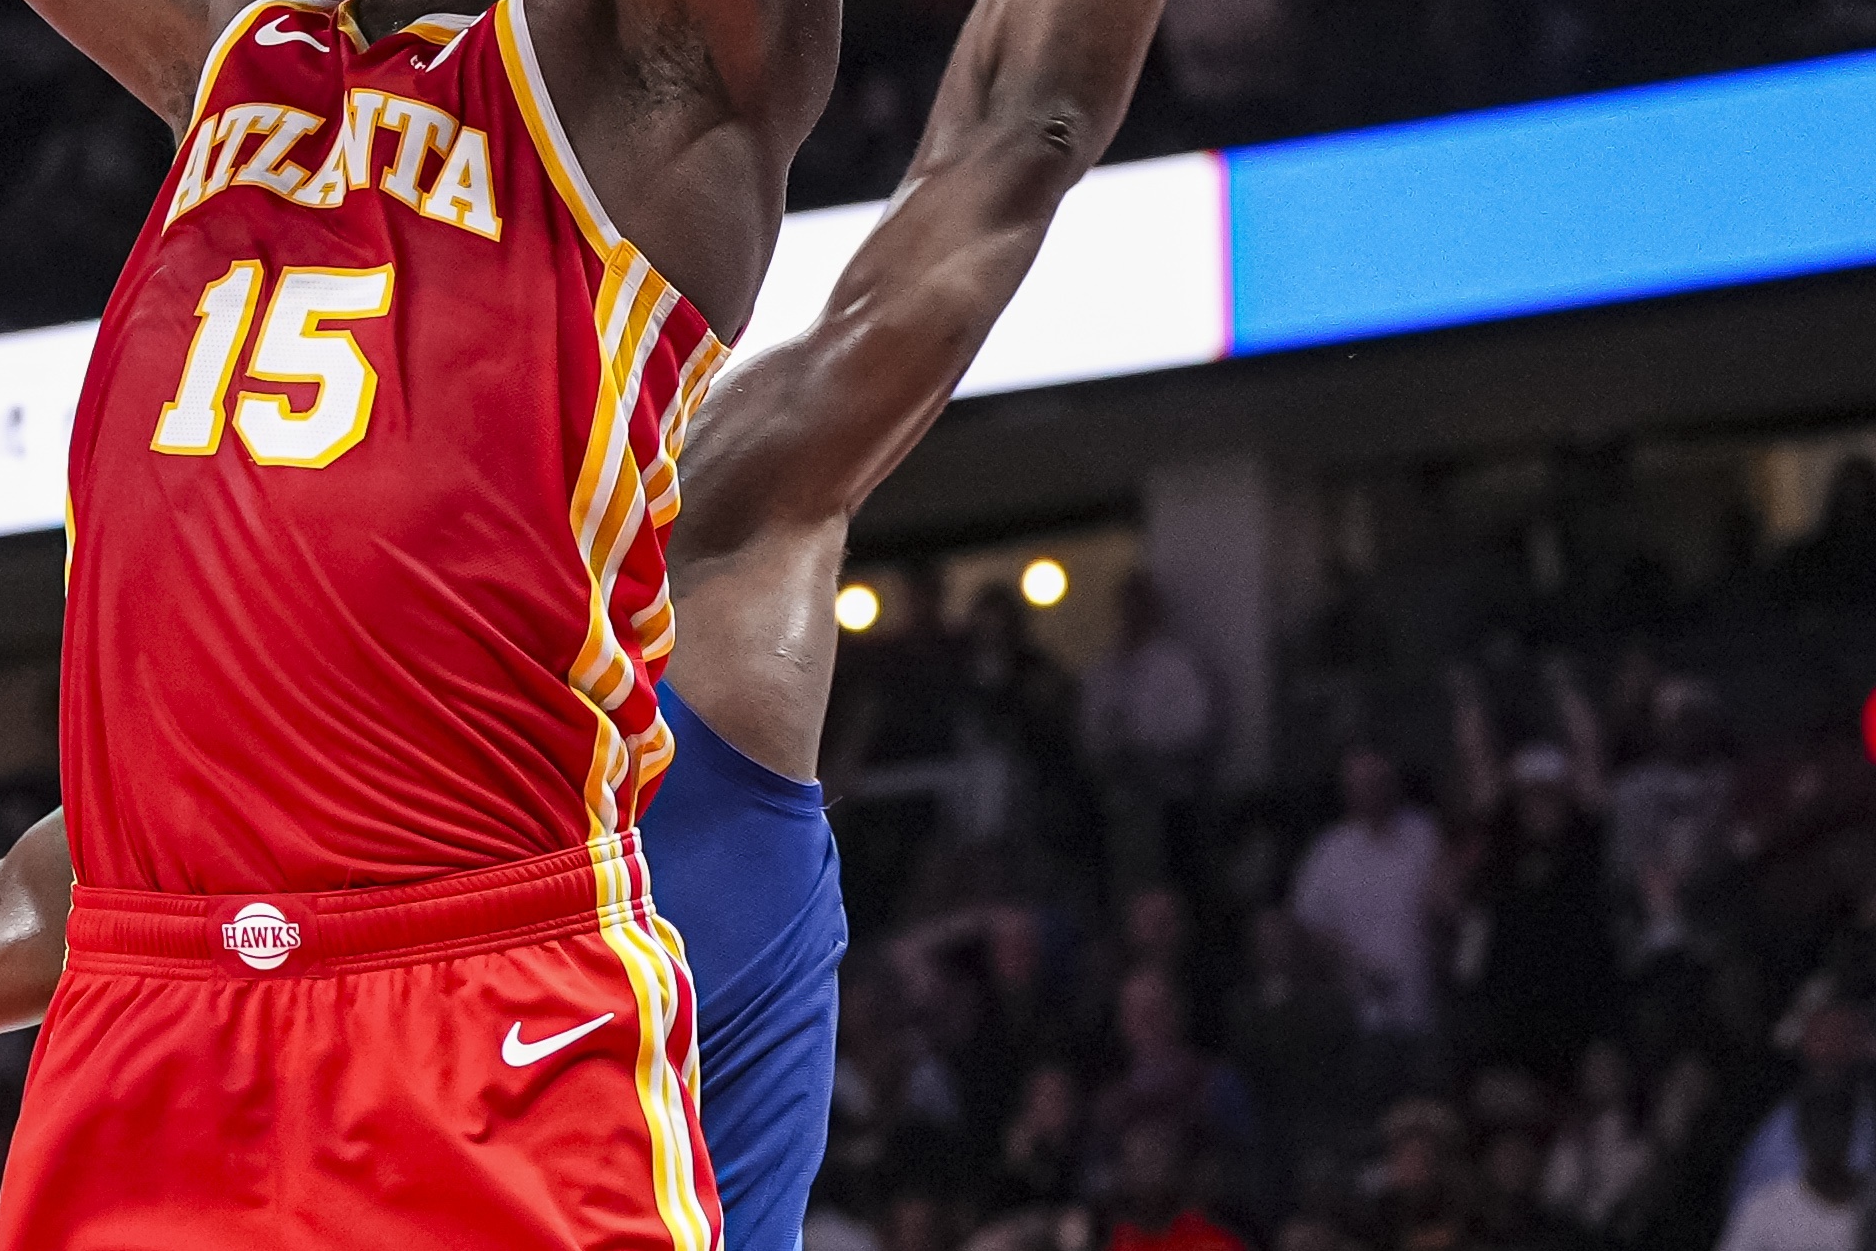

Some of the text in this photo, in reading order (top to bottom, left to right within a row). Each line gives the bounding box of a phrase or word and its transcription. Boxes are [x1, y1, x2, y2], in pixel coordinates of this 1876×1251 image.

[161, 88, 503, 243] ATLANTA
[150, 258, 395, 470] 15
[223, 926, 300, 949] HAWKS
